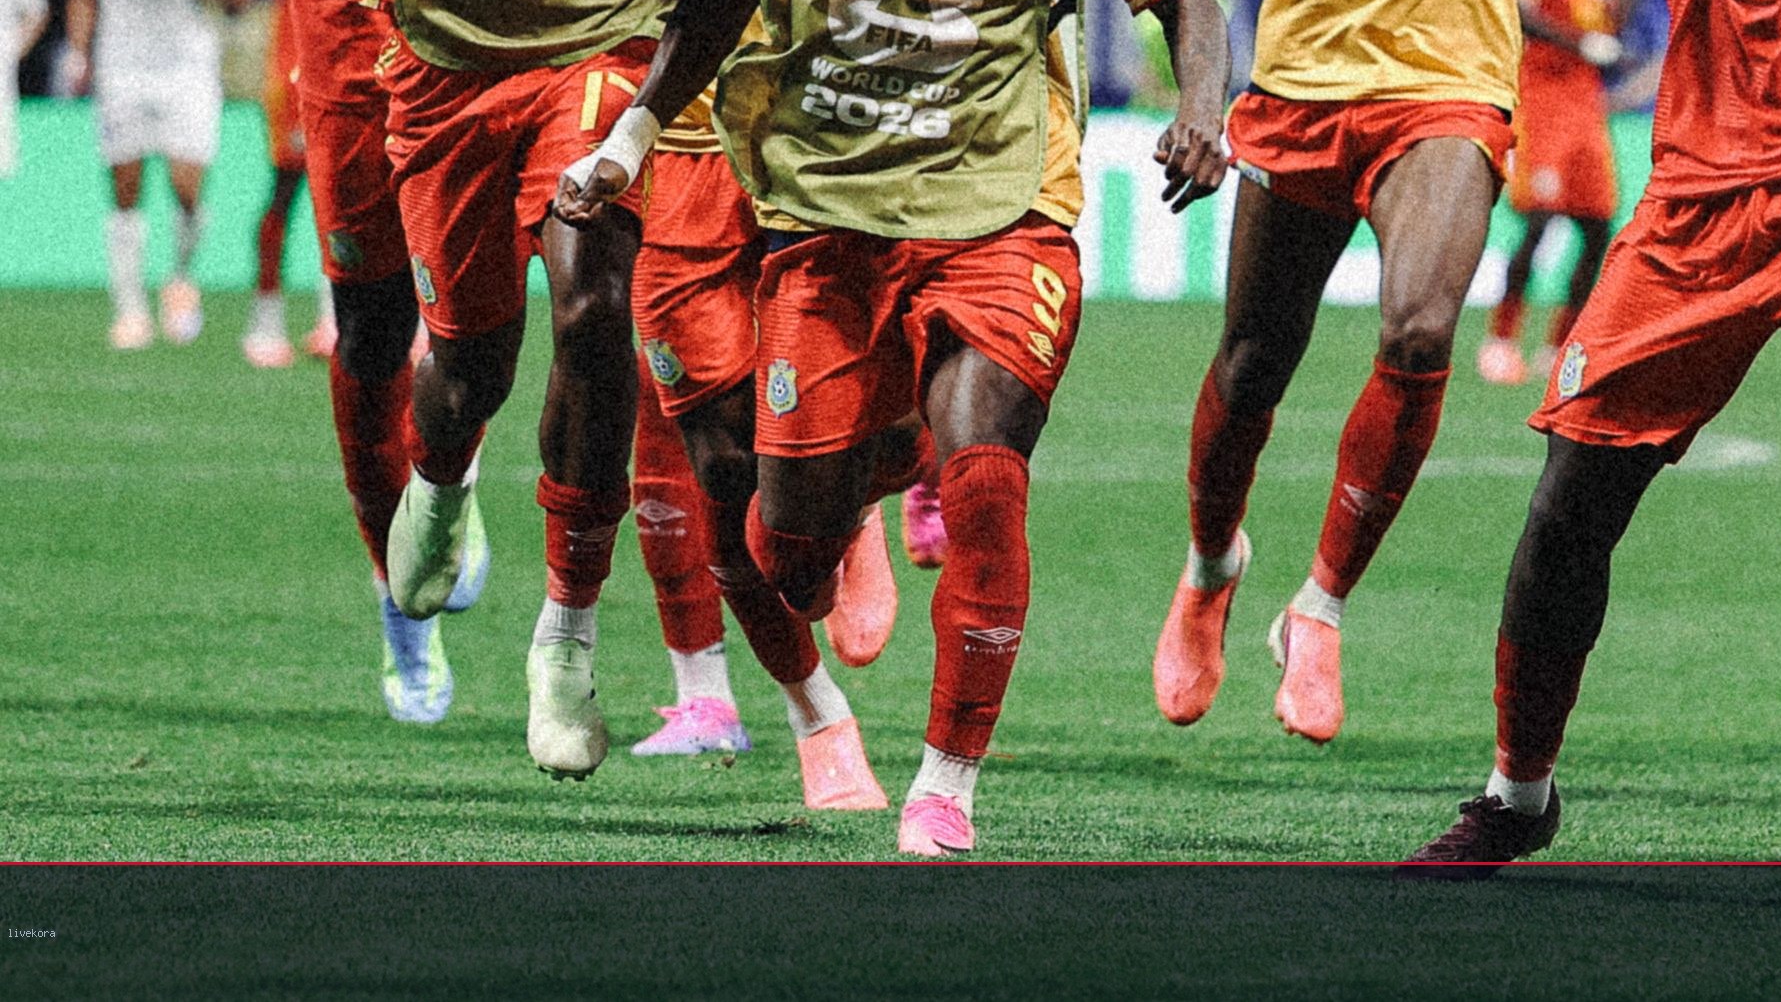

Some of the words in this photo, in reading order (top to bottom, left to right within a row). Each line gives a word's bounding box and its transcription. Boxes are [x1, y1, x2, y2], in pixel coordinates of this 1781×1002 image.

[866, 22, 933, 53] FIFA
[811, 56, 906, 96] WORLD
[909, 81, 961, 104] CUP
[801, 83, 951, 140] 2026
[1031, 263, 1068, 337] 9
